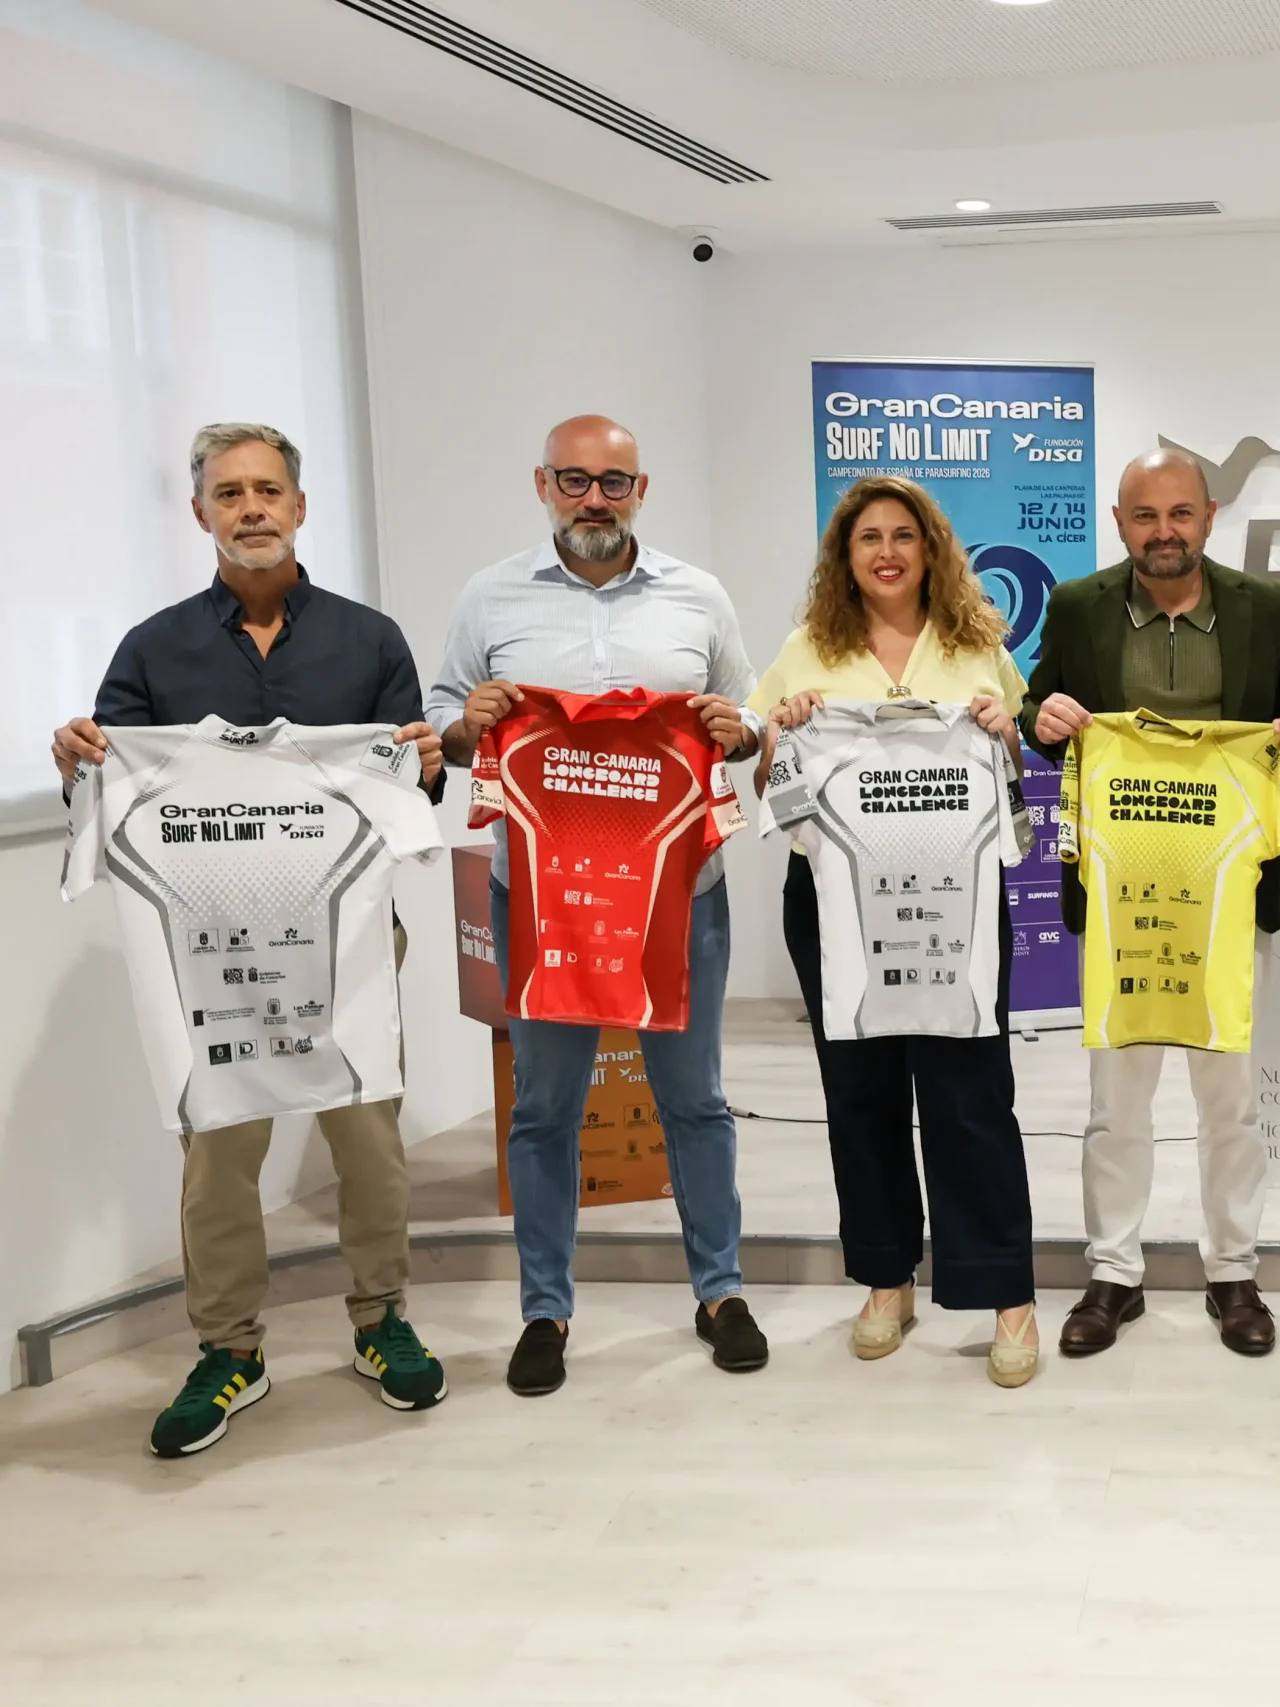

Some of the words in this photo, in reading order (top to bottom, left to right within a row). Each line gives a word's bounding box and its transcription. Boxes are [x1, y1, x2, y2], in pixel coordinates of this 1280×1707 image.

[825, 391, 1084, 420] GranCanaria
[1044, 438, 1083, 447] FUNDACIÓN
[1028, 448, 1082, 462] DISA
[828, 467, 876, 478] CAMPEONATO
[886, 466, 914, 478] ESPAÑA
[915, 467, 924, 478] DE
[925, 467, 971, 478] PARASURFING
[972, 467, 991, 478] 2026
[1018, 502, 1043, 515] 12
[1050, 502, 1058, 515] /
[1064, 502, 1085, 515] 14
[1017, 517, 1086, 530] JUNIO
[1039, 534, 1053, 543] LA
[1056, 532, 1086, 543] CÍCER
[544, 746, 590, 764] GRAN
[593, 752, 661, 773] CANARIA
[543, 762, 660, 787] LONGBOARD
[859, 770, 901, 784] GRAN
[905, 768, 968, 782] CANARIA
[542, 777, 658, 802] CHALLENGE
[859, 784, 969, 799] LONGBOARD
[1109, 778, 1150, 792] GRAN
[1154, 780, 1217, 797] CANARIA
[472, 793, 502, 804] Canaria
[860, 799, 969, 813] CHALLENGE
[1109, 794, 1216, 811] LONGBOARD
[160, 801, 324, 818] GranCanaria
[1110, 809, 1215, 826] CHALLENGE
[290, 830, 324, 839] DISA
